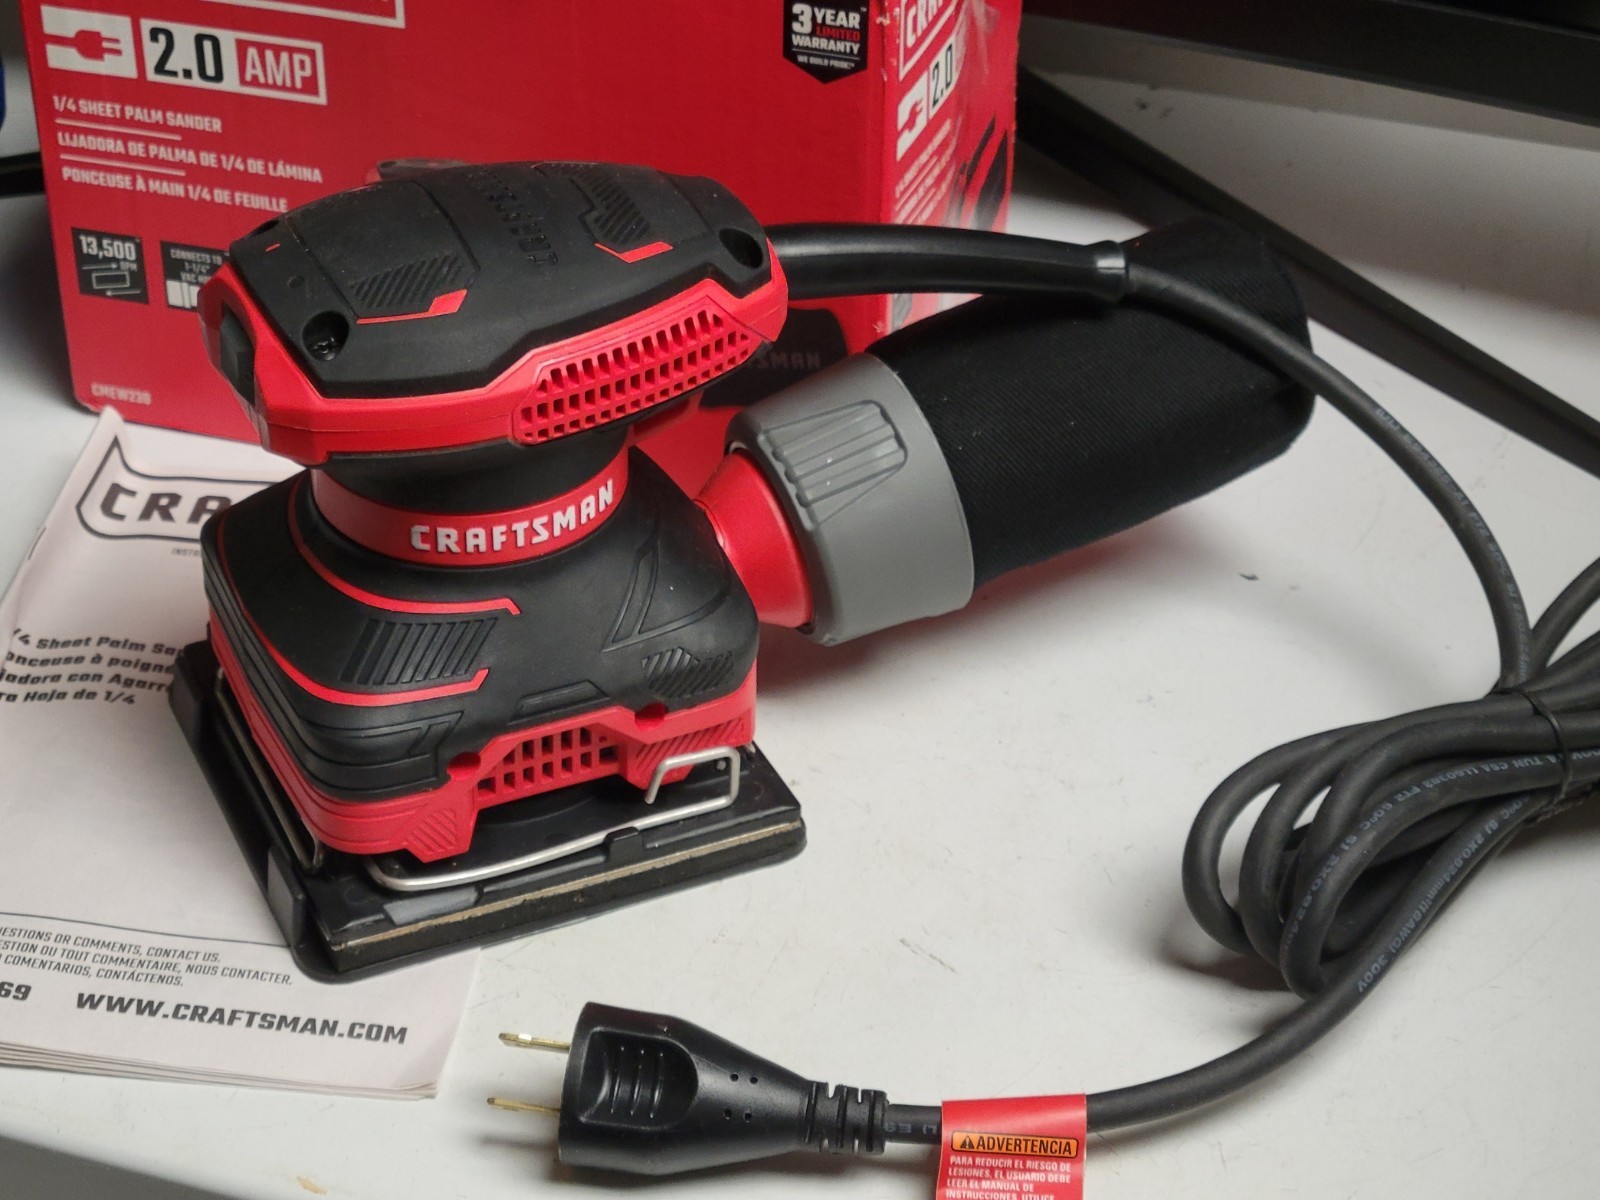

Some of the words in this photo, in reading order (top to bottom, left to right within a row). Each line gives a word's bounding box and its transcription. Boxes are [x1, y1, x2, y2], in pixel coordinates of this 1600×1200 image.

[792, 2, 813, 34] 3
[813, 7, 860, 29] YEAR
[791, 33, 860, 55] WARRANTY
[816, 25, 861, 42] LIMITED
[149, 27, 224, 84] 2.0
[244, 46, 313, 89] AMP
[932, 43, 953, 109] 2.0
[53, 95, 77, 113] 1/4
[78, 98, 122, 118] SHEET
[124, 105, 163, 125] PALM
[165, 111, 222, 133] SANDER
[57, 131, 126, 155] LIJADORA
[127, 140, 147, 157] DE
[148, 144, 197, 165] PALMA
[200, 150, 218, 168] DE
[220, 154, 245, 172] 1/4
[247, 157, 266, 175] DE
[268, 160, 323, 184] LÁMINA
[61, 166, 134, 190] PONCEUSE
[135, 174, 147, 193] À
[148, 179, 185, 198] MAIN
[187, 184, 211, 202] 1/4
[213, 188, 232, 204] DE
[234, 191, 288, 213] FEUILLE
[79, 234, 138, 261] 13,500
[410, 478, 614, 553] CRAFTSMAN
[36, 636, 92, 651] Sheet
[96, 636, 147, 653] Palm
[90, 653, 104, 665] à
[67, 673, 104, 684] con
[23, 691, 68, 703] Hoja
[73, 688, 98, 701] de
[104, 690, 135, 705] 1/4
[1481, 762, 1509, 774] CSA
[54, 933, 72, 945] OR
[73, 936, 143, 957] COMMENTS,
[146, 945, 199, 961] CONTACT
[202, 952, 221, 963] US.
[4, 953, 92, 978] COMENTARIOS,
[96, 967, 184, 987] CONTÁCTENOS.
[40, 945, 58, 957] OU
[60, 948, 93, 962] TOUT
[92, 953, 182, 974] COMMENTAIRE,
[185, 964, 219, 976] NOUS
[220, 966, 293, 986] CONTACTER.
[1357, 955, 1388, 993] 300V
[76, 991, 408, 1045] WWW.CRAFTSMAN.COM
[976, 1135, 1072, 1155] ADVERTENCIA
[948, 1167, 992, 1179] LESIONES,
[994, 1169, 1004, 1180] EL
[1006, 1171, 1046, 1182] USUARIO
[1047, 1173, 1071, 1184] DEBE
[949, 1155, 973, 1166] PARA
[975, 1157, 1012, 1169] REDUCIR
[1014, 1158, 1024, 1169] EL
[1026, 1160, 1058, 1171] RIESGO
[1060, 1162, 1072, 1173] DE
[946, 1178, 968, 1189] LEER
[969, 1179, 980, 1189] EL
[981, 1180, 1020, 1192] MANUAL
[1022, 1182, 1035, 1193] DE
